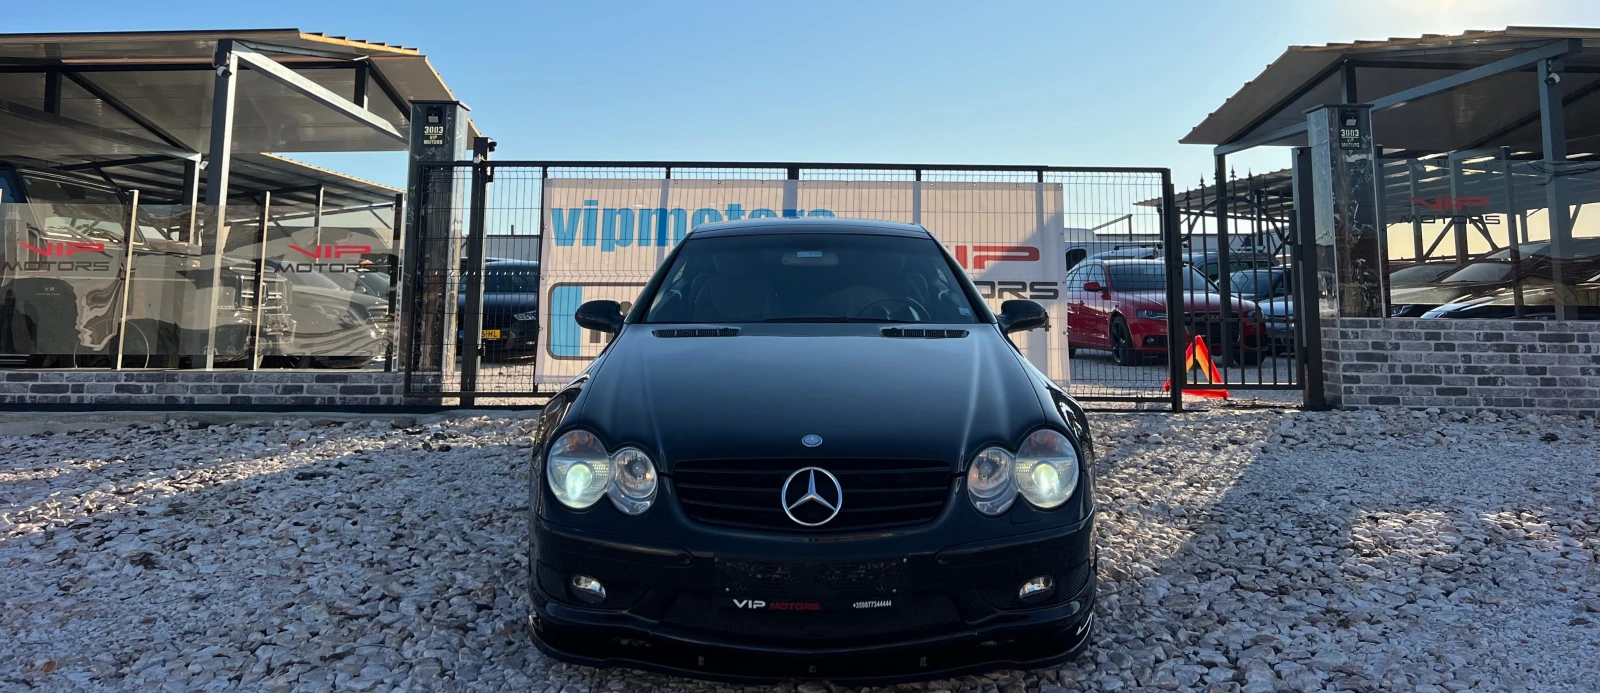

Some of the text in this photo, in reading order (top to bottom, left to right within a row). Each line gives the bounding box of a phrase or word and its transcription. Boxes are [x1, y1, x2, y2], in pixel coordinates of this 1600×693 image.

[424, 126, 444, 134] 3003
[1341, 129, 1360, 137] 3003
[1410, 196, 1490, 210] VIP
[1400, 214, 1501, 224] MOTORS
[17, 242, 105, 256] VIP
[287, 244, 372, 259] VIP
[945, 245, 1040, 269] IP
[3, 261, 110, 272] MOTORS
[274, 263, 379, 273] MOTORS
[973, 280, 1059, 299] ORS
[732, 598, 820, 611] VIP MOTORS
